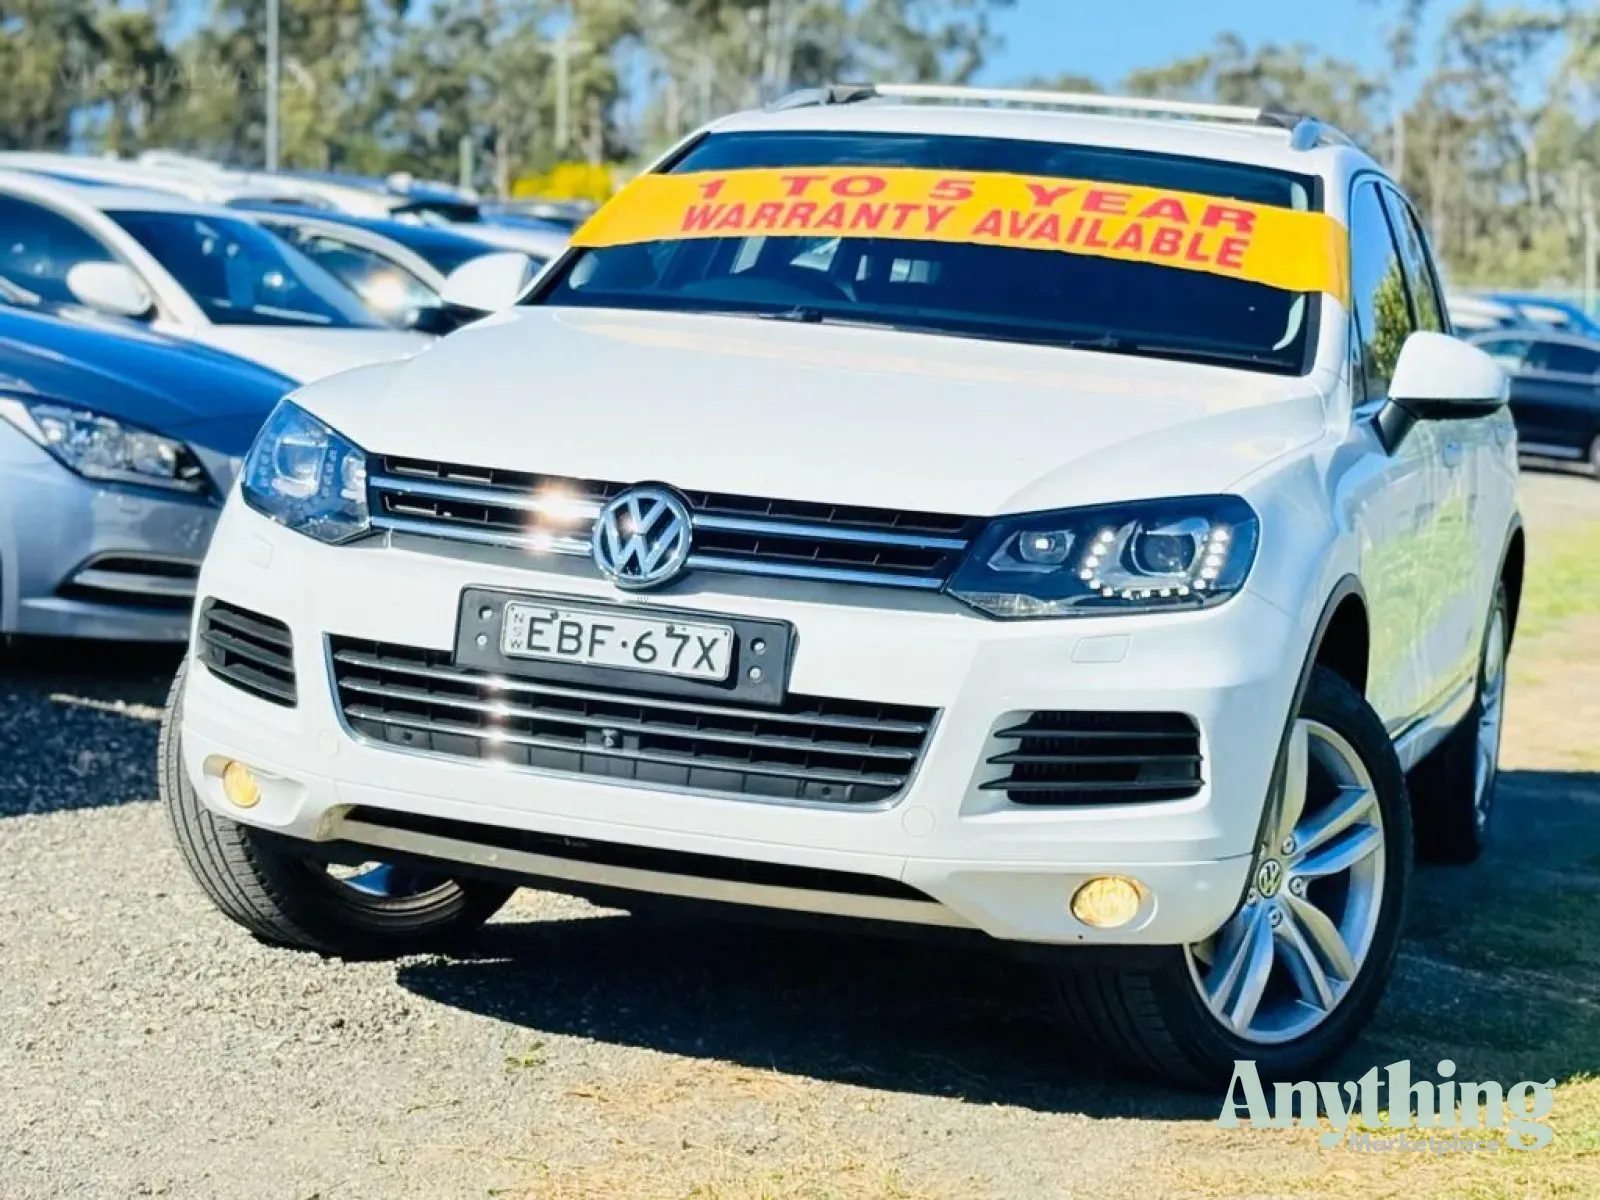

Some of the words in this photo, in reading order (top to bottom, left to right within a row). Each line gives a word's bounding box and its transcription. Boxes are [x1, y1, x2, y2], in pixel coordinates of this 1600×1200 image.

[681, 201, 957, 232] WARRANTY
[971, 209, 1251, 270] AVAILABLE
[698, 178, 728, 200] 1
[781, 175, 886, 197] TO
[929, 179, 974, 201] 5
[1026, 183, 1258, 234] YEAR
